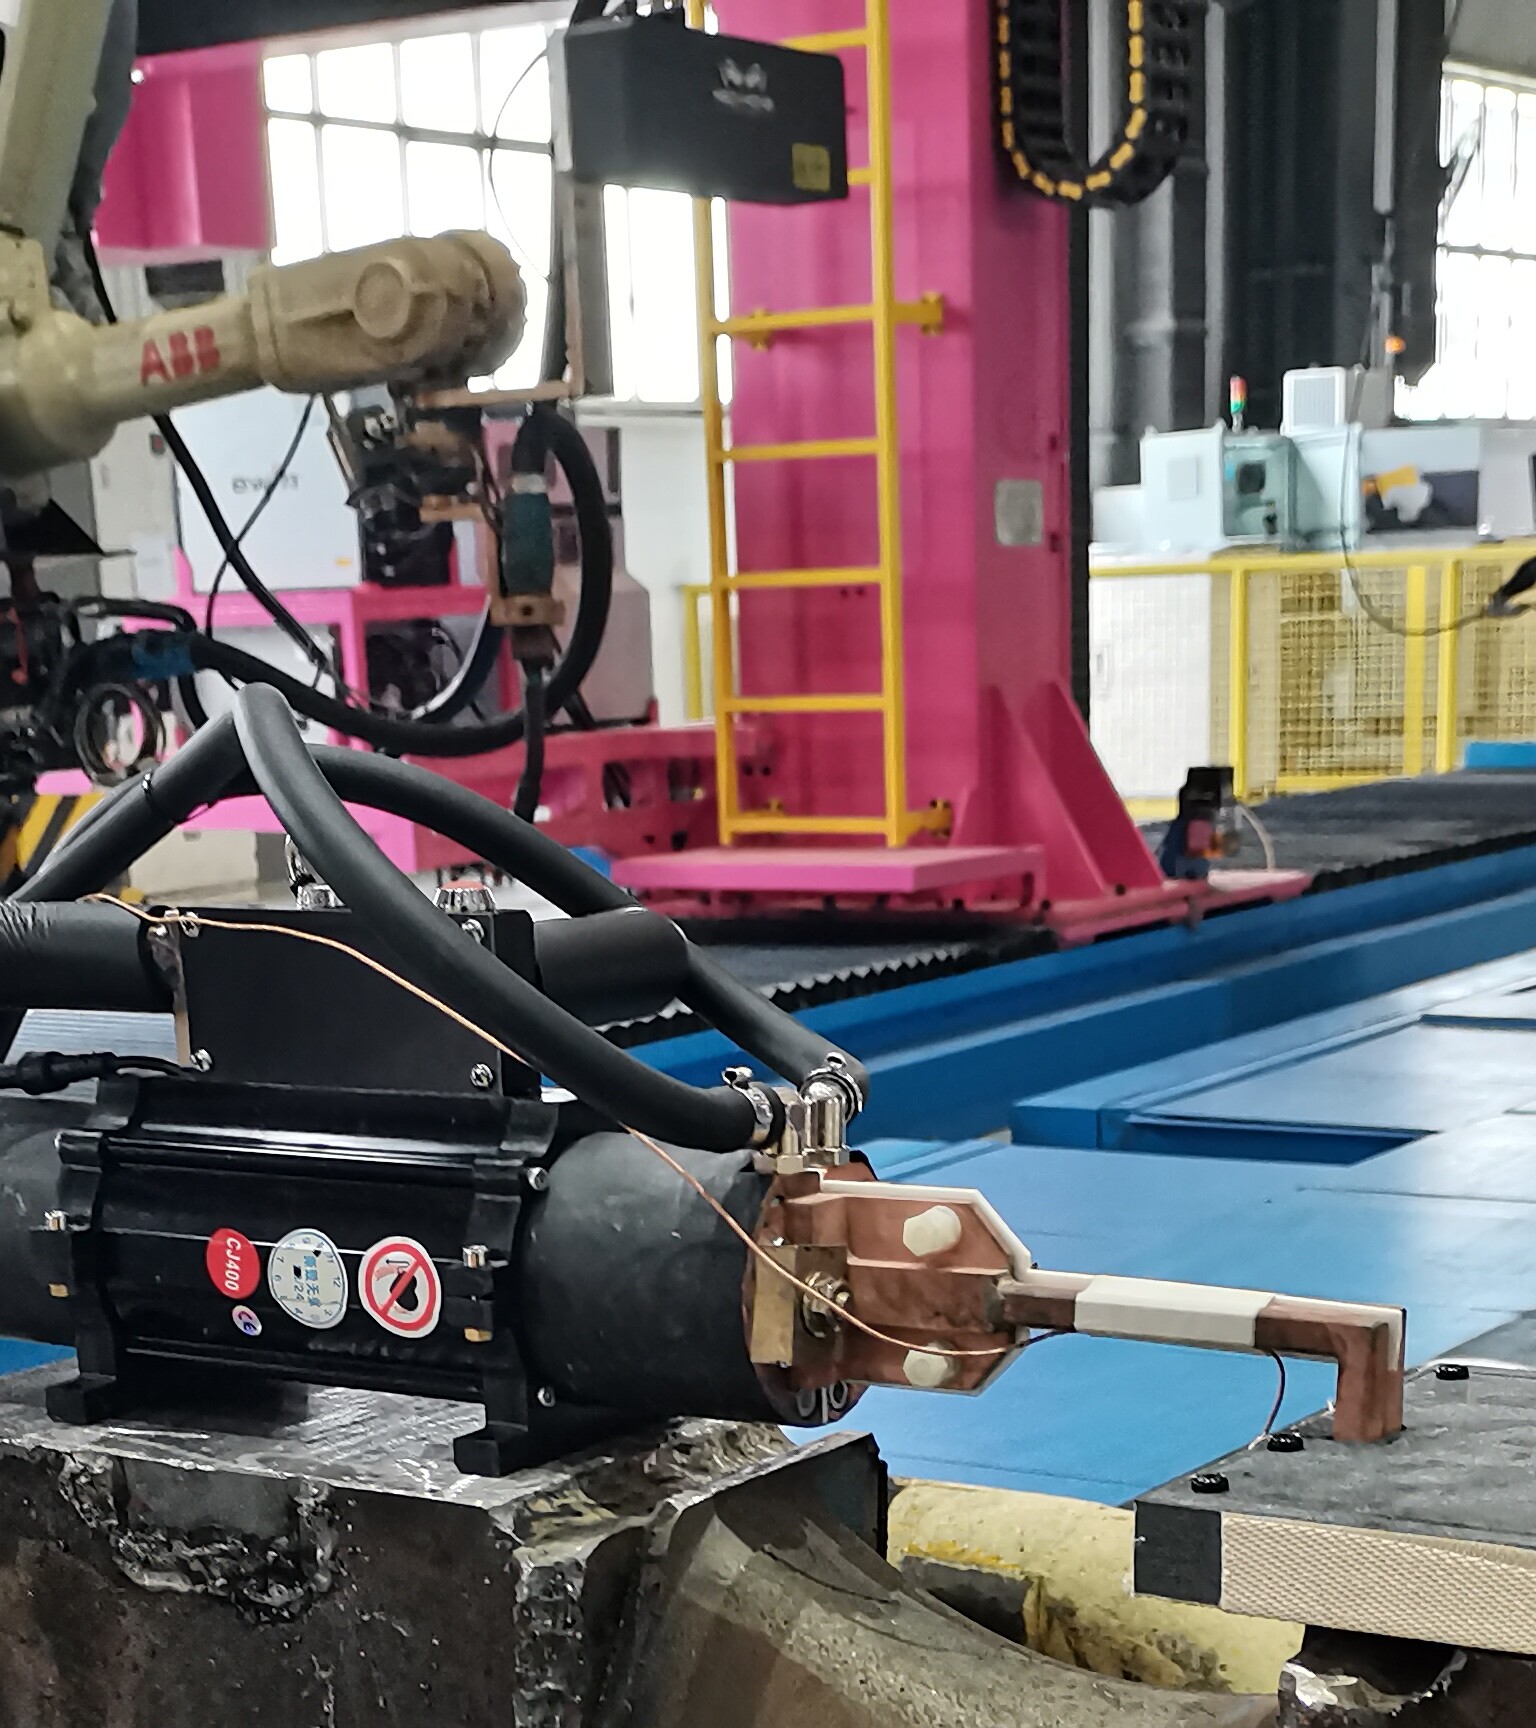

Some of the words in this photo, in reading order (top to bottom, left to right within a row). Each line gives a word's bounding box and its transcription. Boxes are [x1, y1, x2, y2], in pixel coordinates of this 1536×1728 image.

[140, 325, 221, 386] ABB
[225, 1237, 241, 1291] CJ400
[333, 1276, 341, 1289] 12
